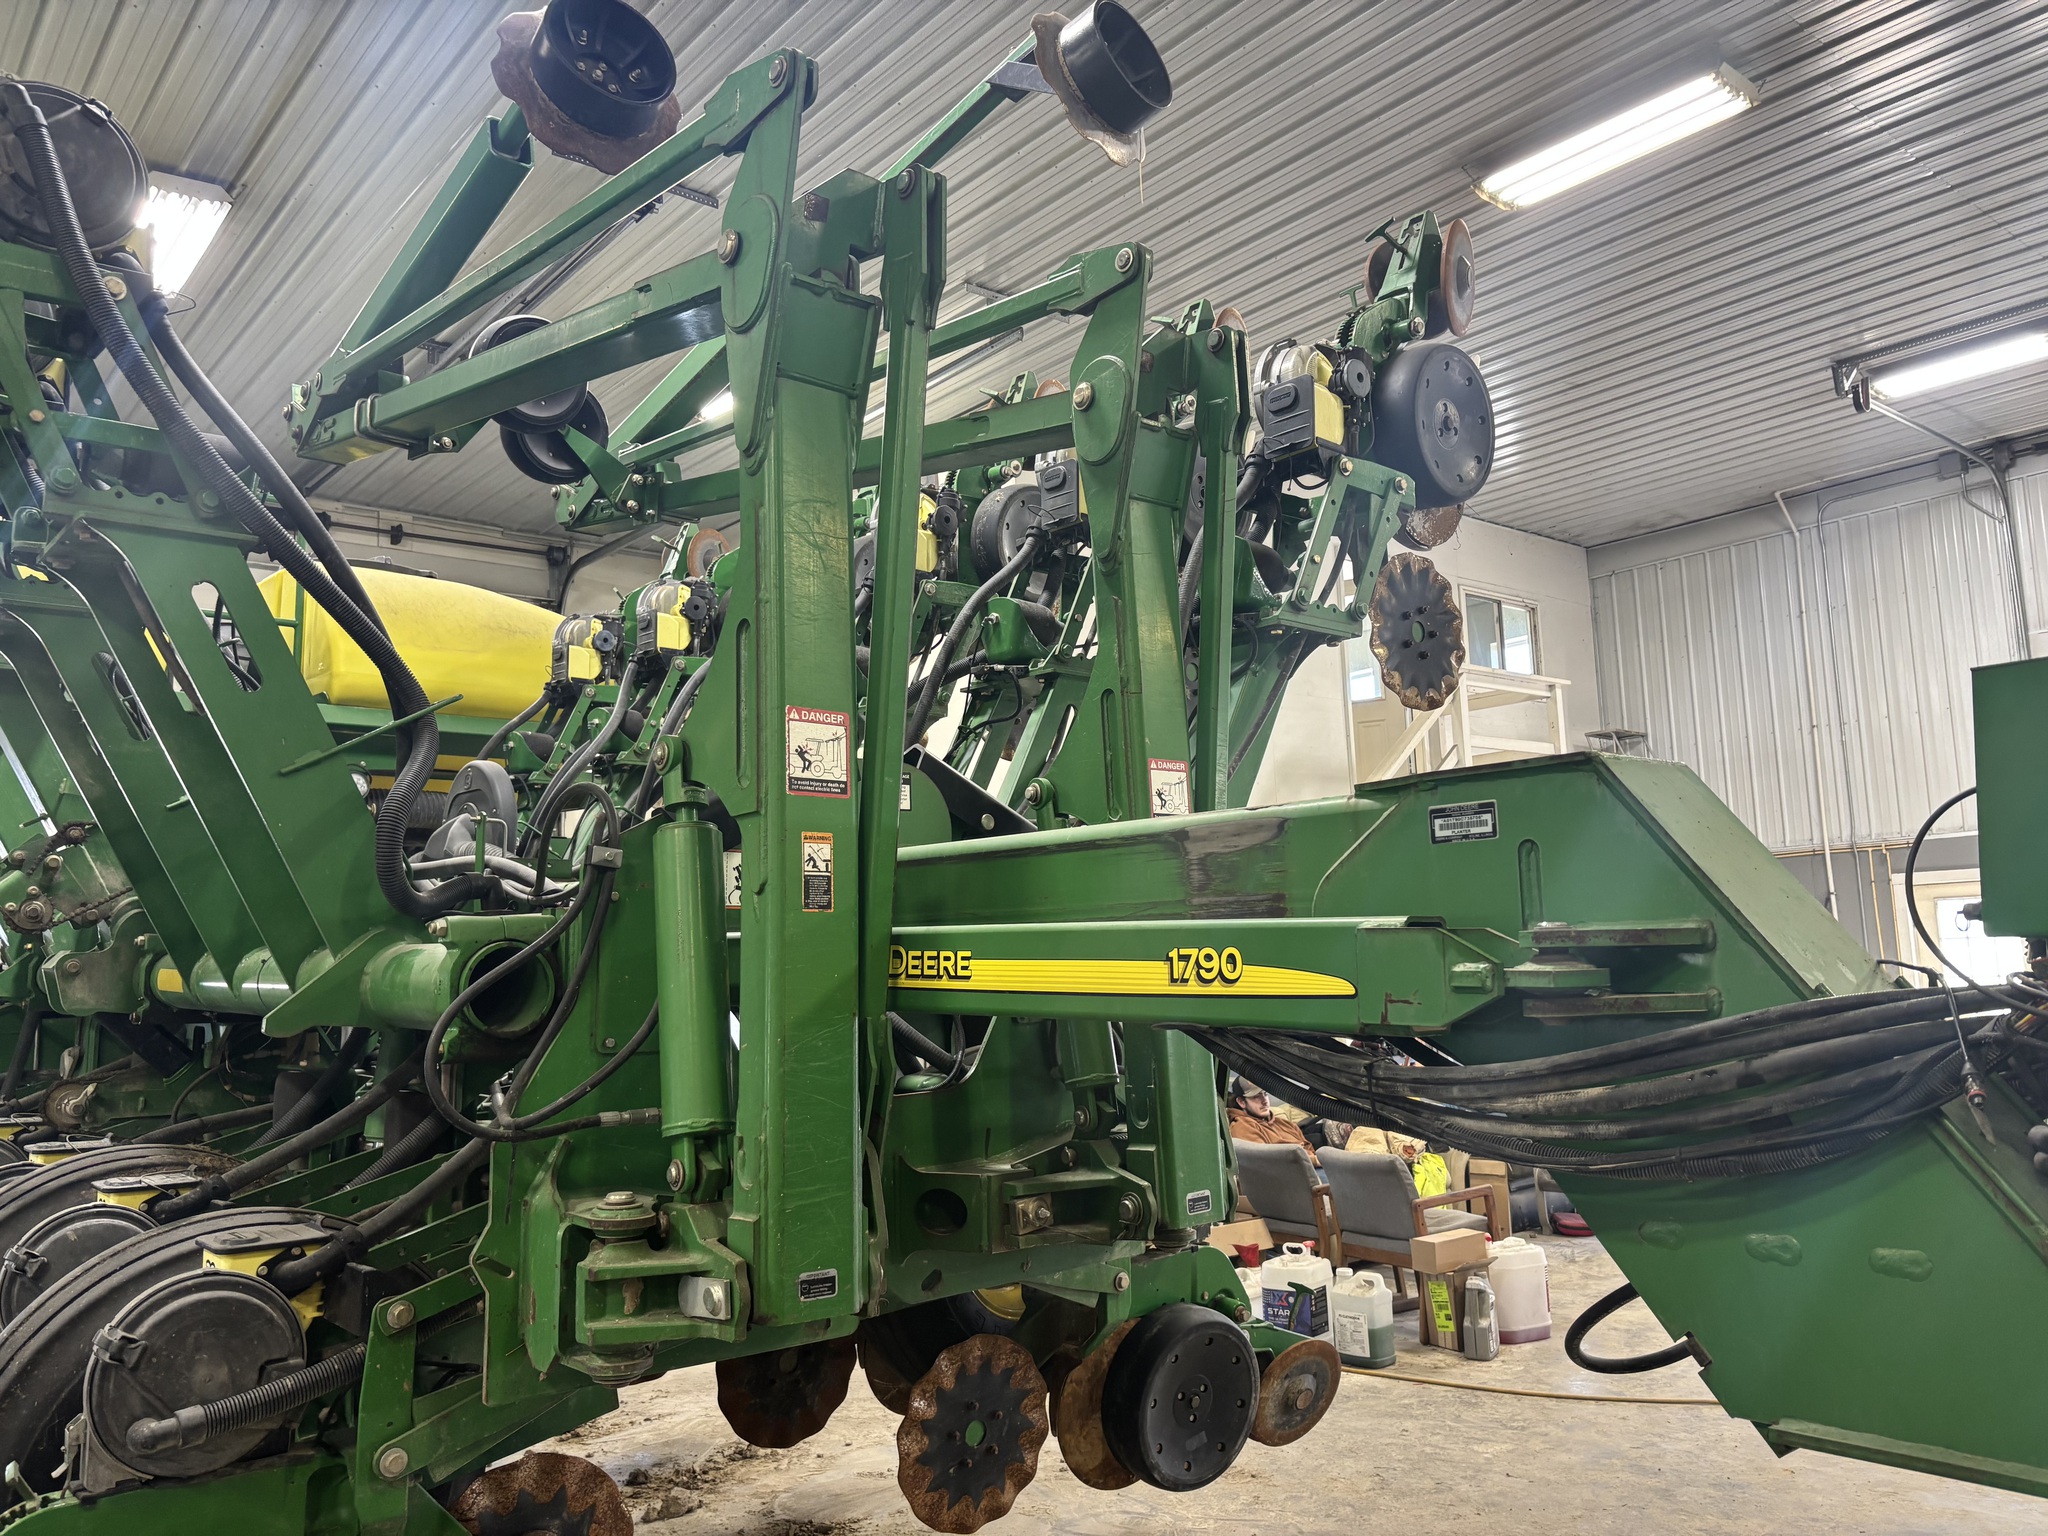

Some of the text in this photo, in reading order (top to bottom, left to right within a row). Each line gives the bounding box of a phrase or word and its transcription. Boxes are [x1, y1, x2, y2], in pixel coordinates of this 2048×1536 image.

[802, 711, 844, 724] DANGER
[1158, 762, 1185, 770] DANGER
[889, 945, 1243, 985] DEERE 1790
